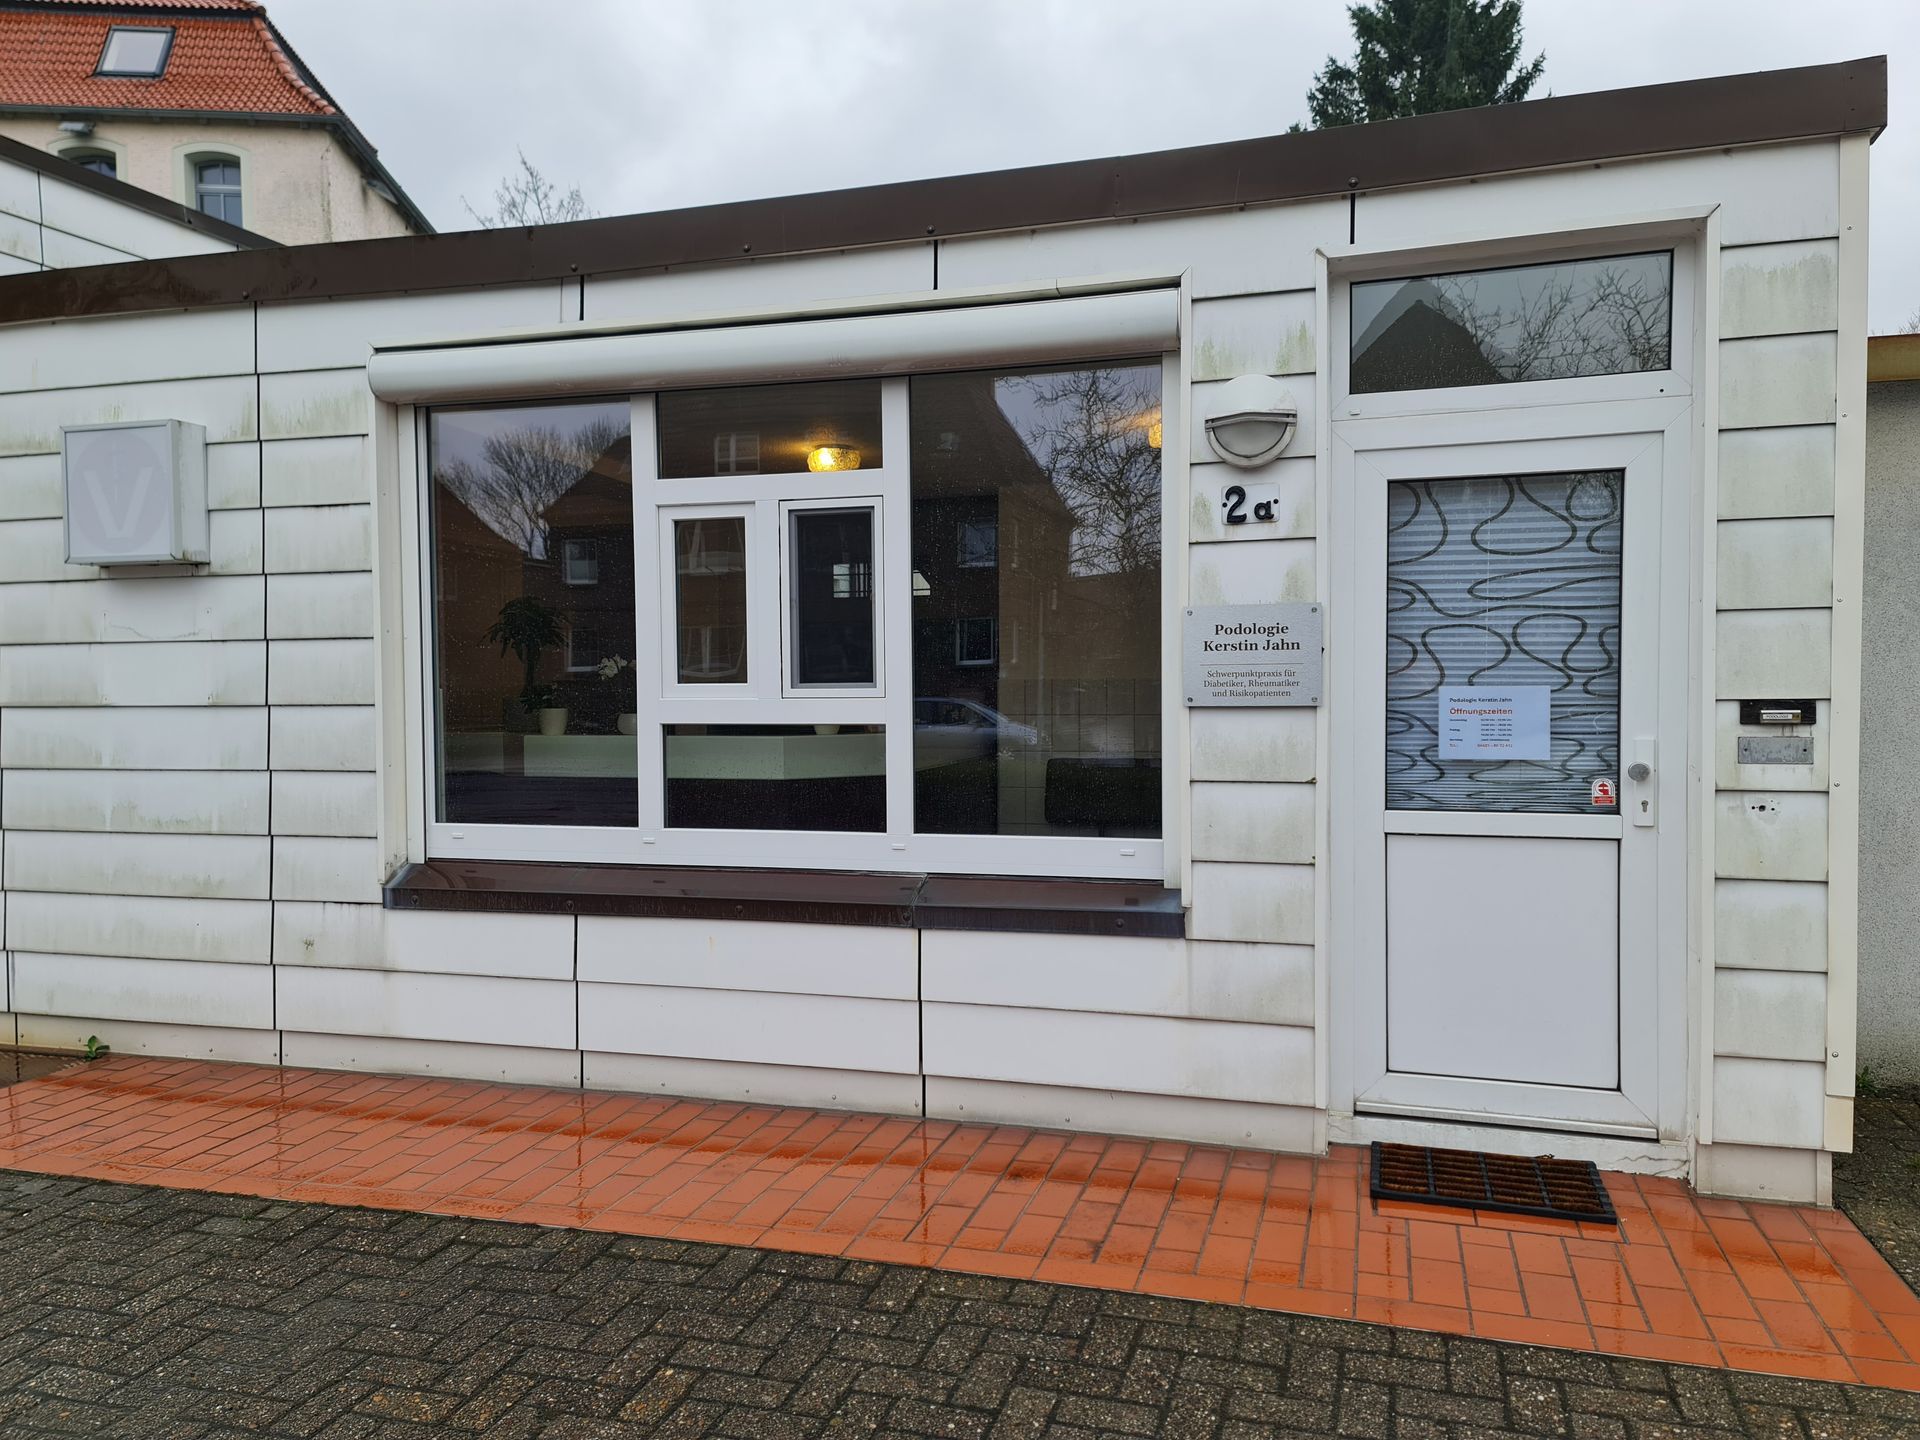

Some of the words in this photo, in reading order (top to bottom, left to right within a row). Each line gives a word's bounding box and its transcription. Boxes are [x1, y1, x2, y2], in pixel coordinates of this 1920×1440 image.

[1225, 485, 1275, 523] 2a
[1214, 622, 1289, 638] Podologie
[1203, 639, 1259, 652] Kerstin
[1262, 638, 1301, 651] Jahn
[1207, 669, 1282, 679] Schwerpunktpraxis
[1284, 669, 1296, 677] für
[1203, 679, 1246, 688] Diabetiker,
[1248, 679, 1301, 688] Rheumatiker
[1212, 689, 1227, 697] und
[1229, 689, 1291, 698] Risikopatienten
[1449, 706, 1513, 716] Öffnungszeiten
